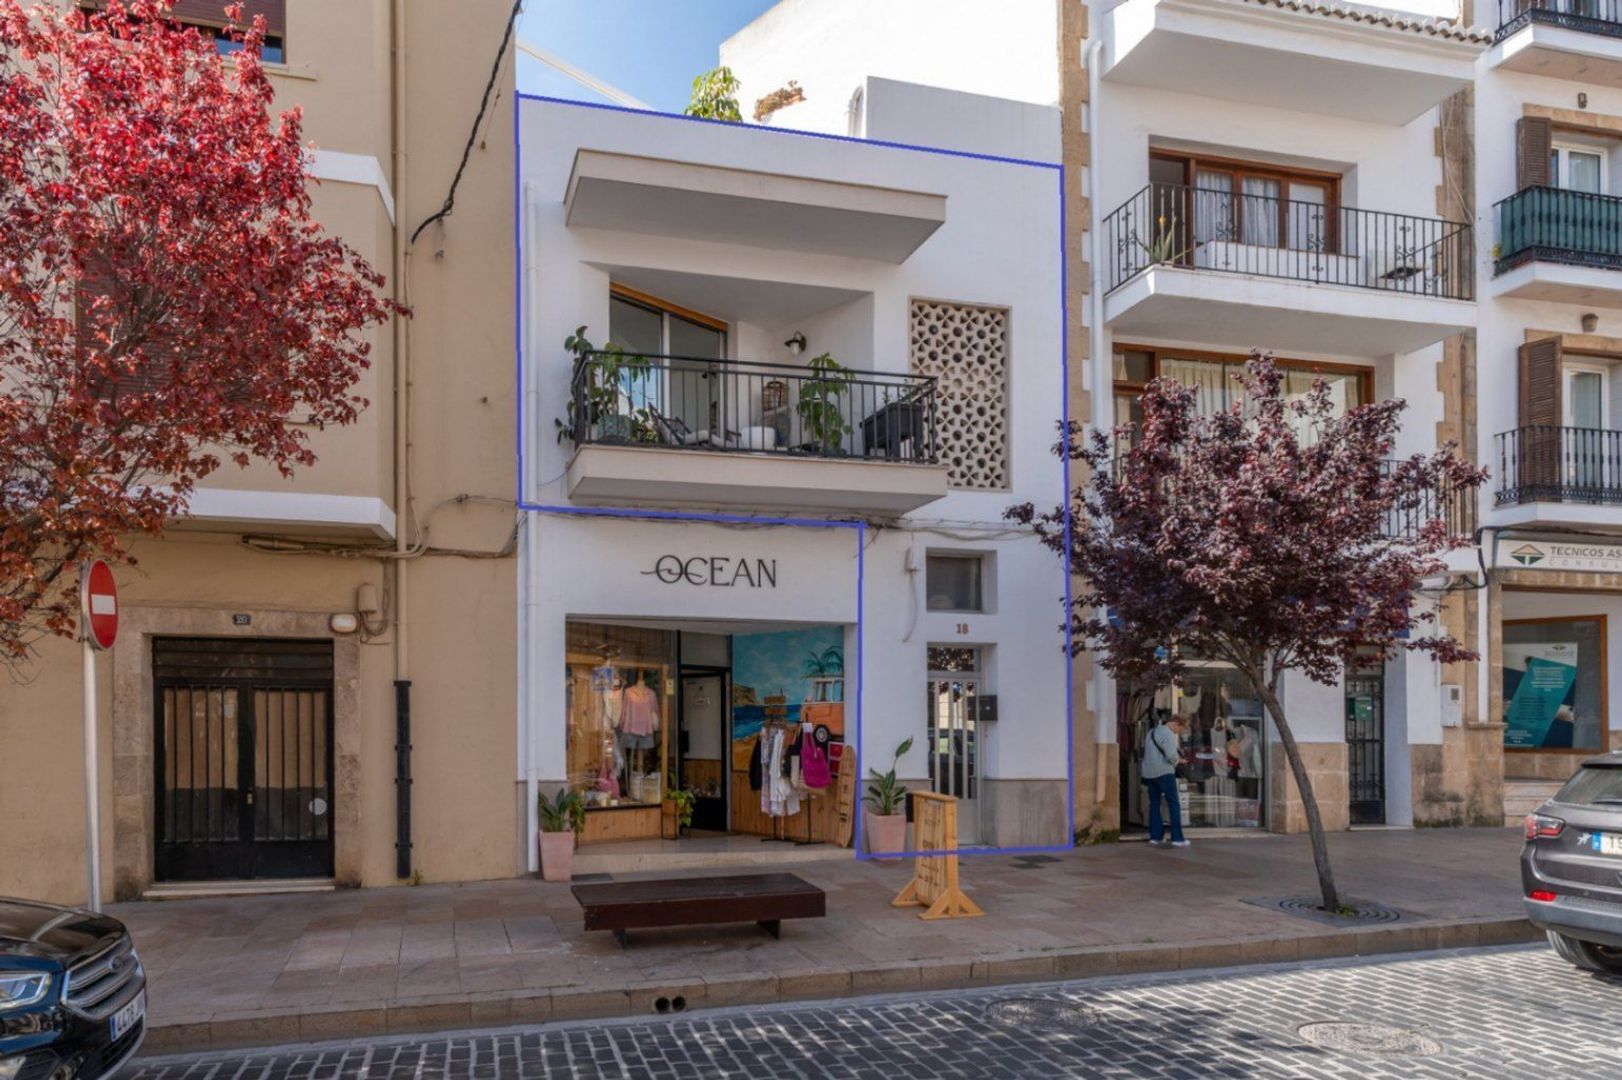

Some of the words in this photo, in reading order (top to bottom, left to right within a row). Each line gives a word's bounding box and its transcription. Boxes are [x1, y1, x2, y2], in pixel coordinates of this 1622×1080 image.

[1550, 546, 1604, 557] TECNICOS
[641, 554, 777, 588] OCEAN
[956, 623, 969, 635] 18
